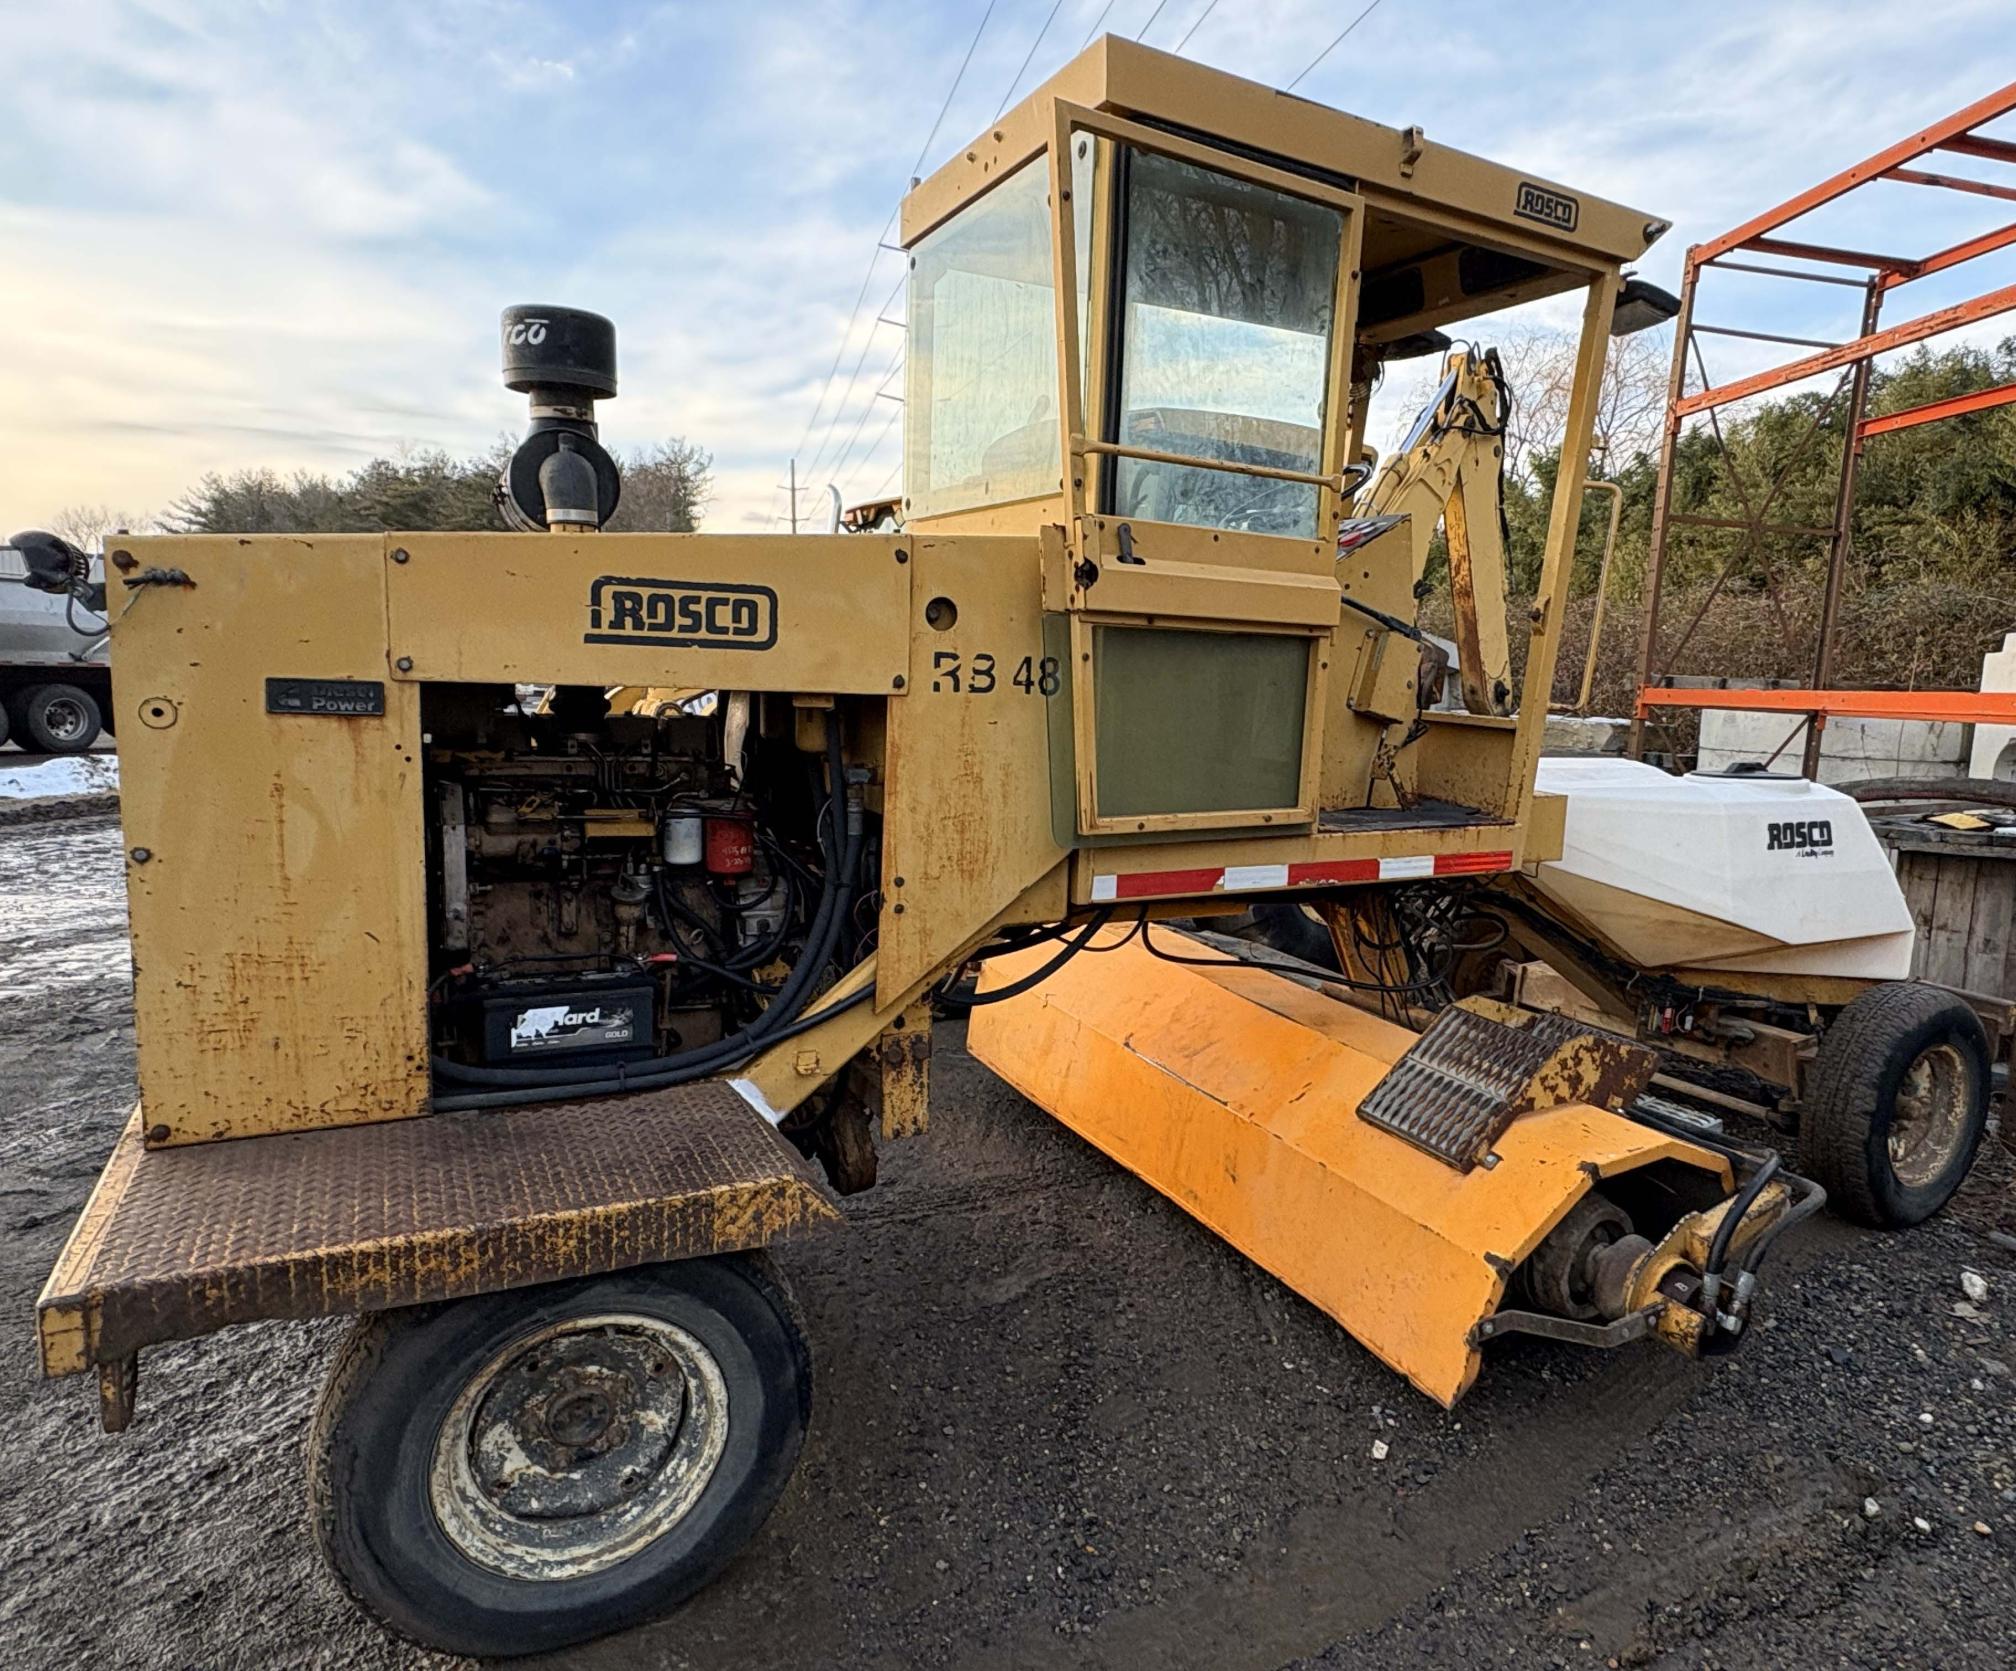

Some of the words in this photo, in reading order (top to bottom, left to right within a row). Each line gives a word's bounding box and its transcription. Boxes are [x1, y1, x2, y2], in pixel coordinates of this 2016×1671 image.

[1521, 189, 1573, 224] ROSCO
[608, 591, 758, 636] ROSCO
[1012, 656, 1061, 697] 48
[311, 697, 376, 712] Power
[1767, 821, 1833, 850] ROSCO
[604, 1029, 629, 1040] GOLD
